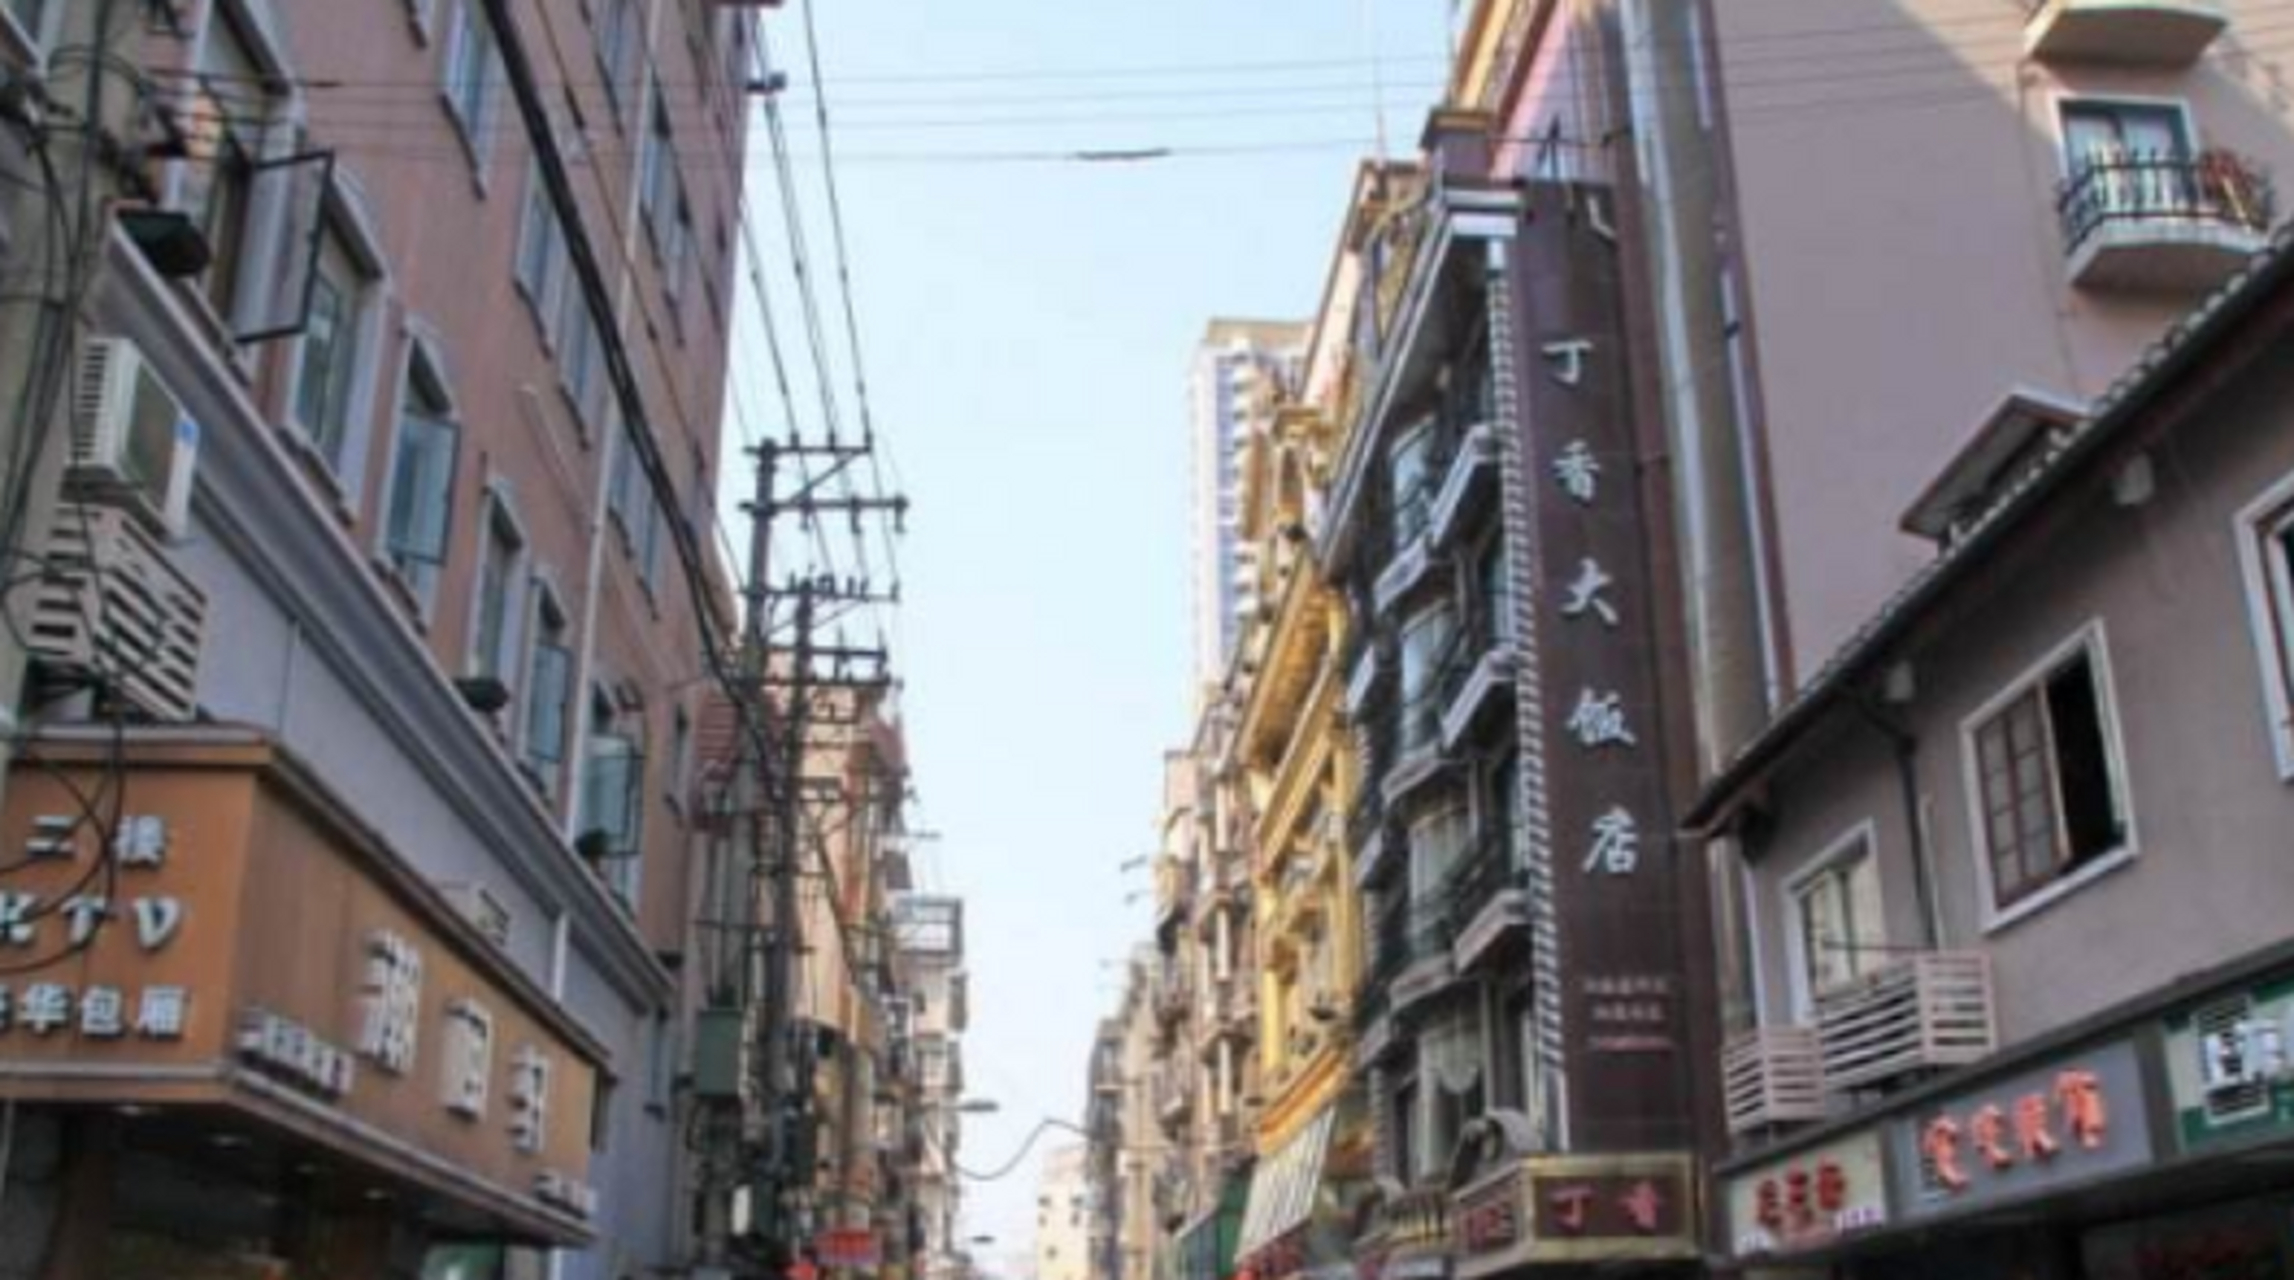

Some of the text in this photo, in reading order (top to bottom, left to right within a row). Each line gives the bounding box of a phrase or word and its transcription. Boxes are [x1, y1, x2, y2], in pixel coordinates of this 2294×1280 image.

[1543, 339, 1639, 874] 丁香大饭店
[0, 983, 187, 1038] 华包厢
